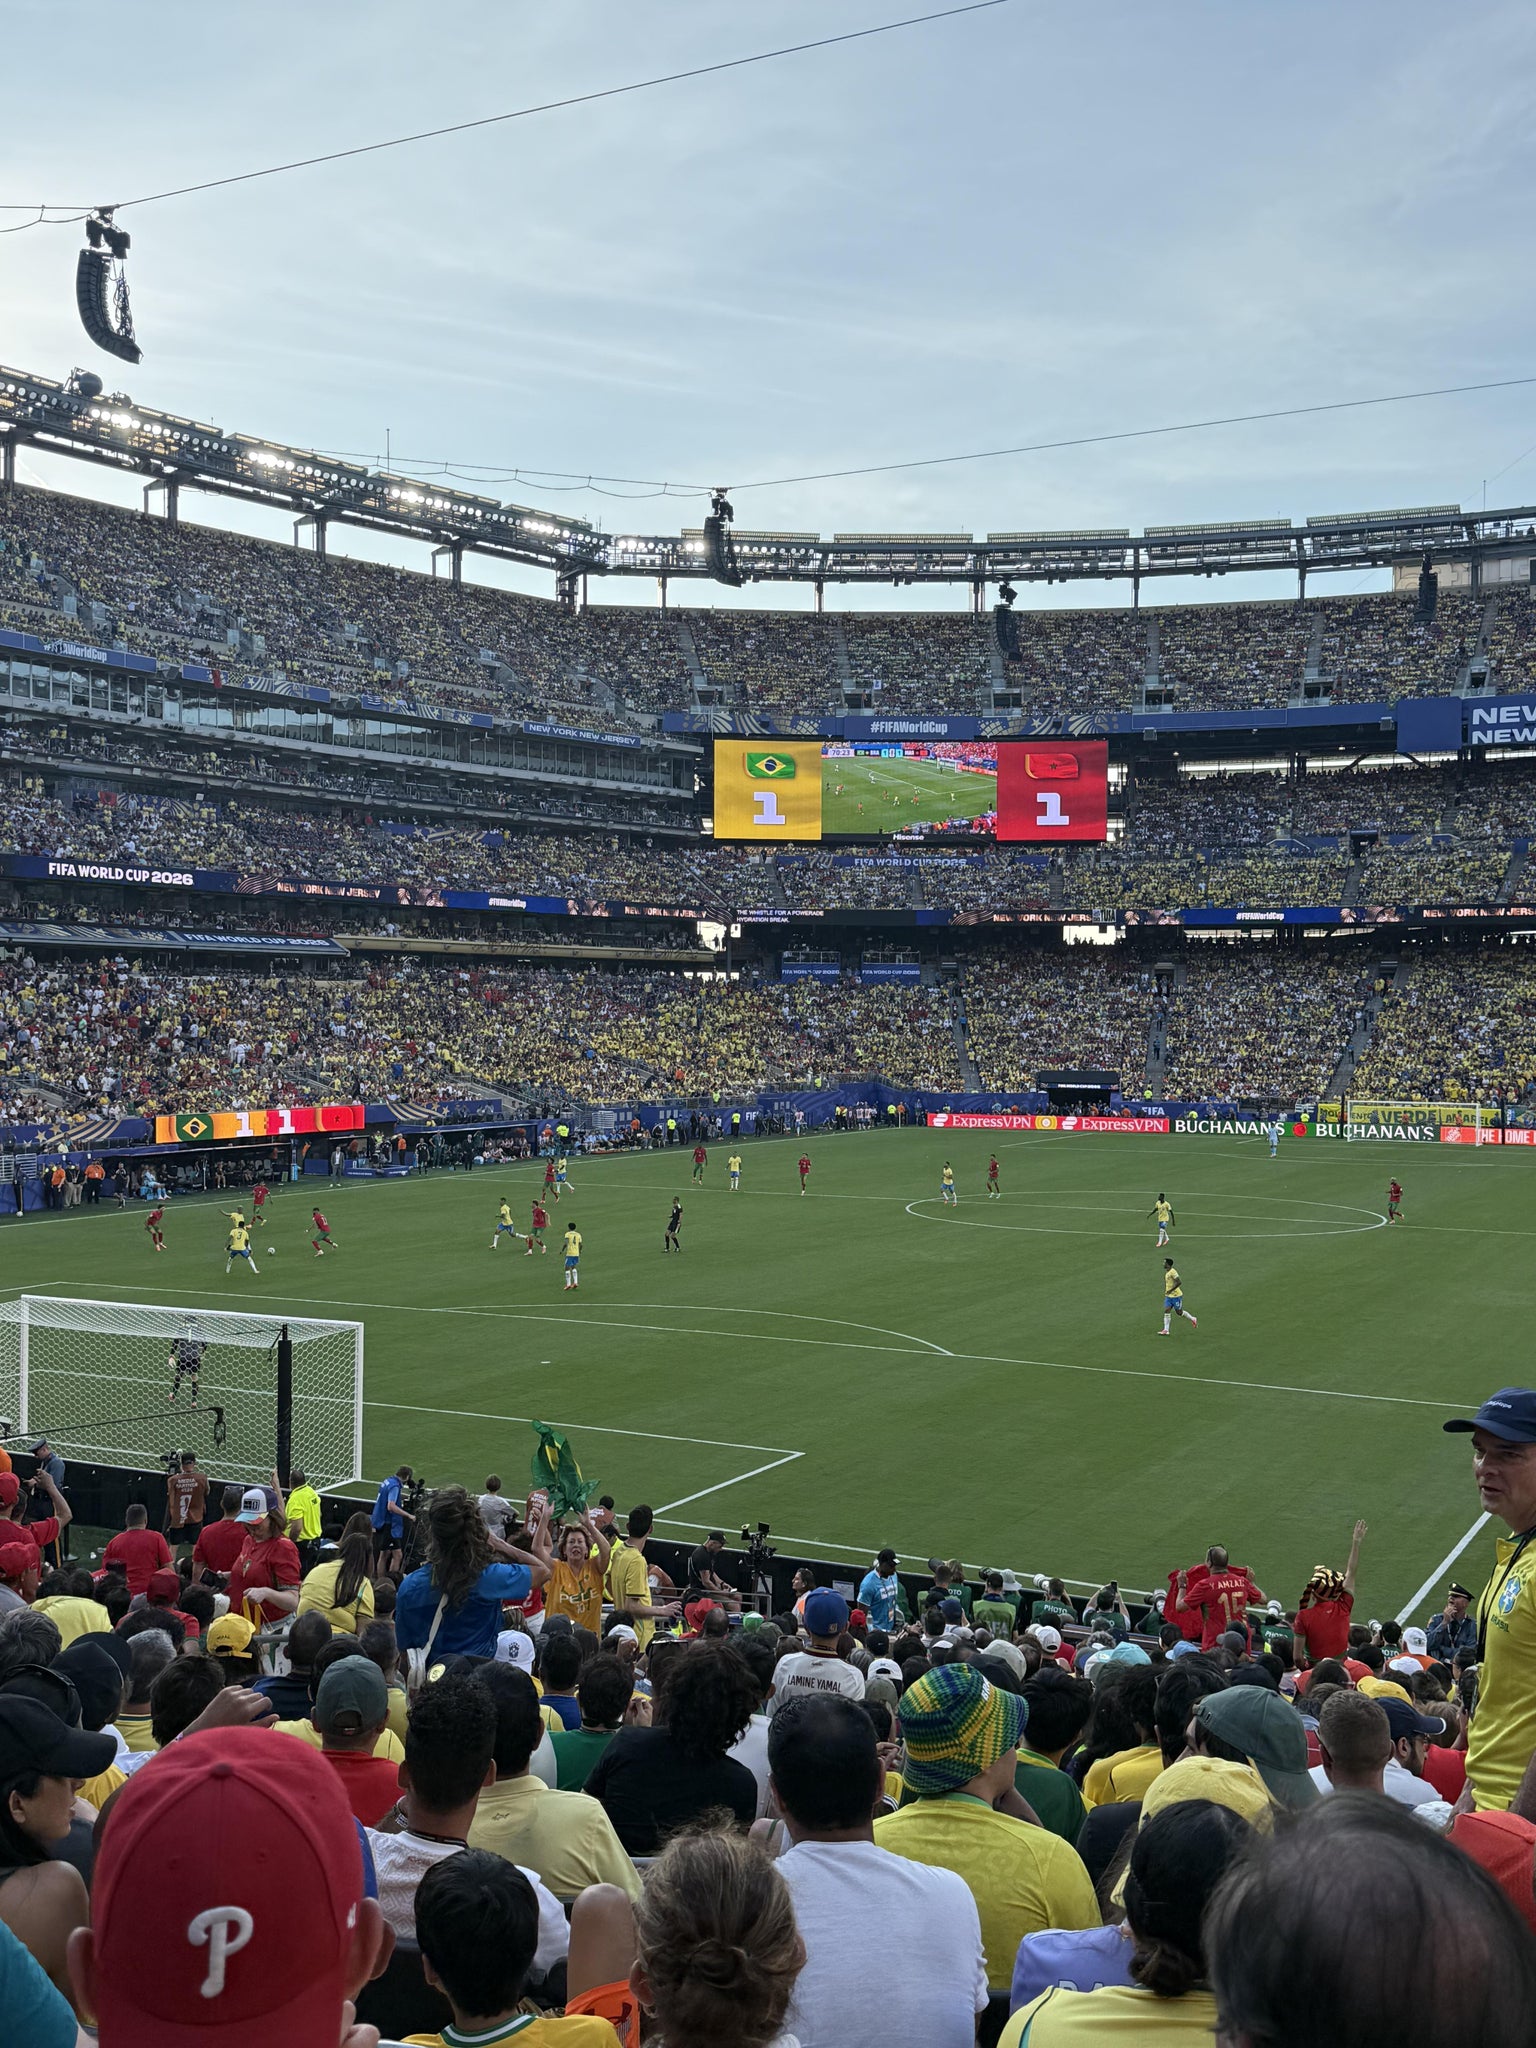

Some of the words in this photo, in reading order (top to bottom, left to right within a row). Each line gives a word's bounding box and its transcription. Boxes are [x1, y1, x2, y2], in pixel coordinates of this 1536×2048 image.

[529, 724, 551, 733] NEW
[553, 727, 578, 737] YORK
[579, 731, 600, 740] NEW
[601, 735, 636, 745] JERSEY
[870, 721, 948, 735] #FIFAWorldCup
[1471, 728, 1536, 745] NEW
[753, 791, 786, 825] 1
[1036, 792, 1070, 826] 1
[48, 862, 77, 877] FIFA
[78, 865, 124, 881] WORLD
[125, 869, 150, 882] CUP
[151, 871, 194, 886] 2026
[277, 882, 298, 893] NEW
[301, 884, 323, 895] YORK
[625, 906, 641, 915] NEW
[643, 908, 662, 916] YORK
[993, 914, 1013, 922] NEW
[1018, 914, 1043, 922] YORK
[1067, 914, 1092, 922] JERS
[1236, 912, 1285, 921] #FIFAWorldCup
[1423, 909, 1447, 918] NEW
[1449, 908, 1478, 917] YORK
[1506, 907, 1536, 916] JERS
[184, 933, 214, 942] FIFA
[214, 935, 261, 944] WORLD
[262, 937, 287, 945] CUP
[287, 938, 330, 946] 2026
[1141, 1106, 1165, 1116] FIFA
[236, 1112, 254, 1138] 1
[278, 1109, 296, 1135] 1
[952, 1115, 1031, 1128] ExpressVPN
[1081, 1118, 1164, 1132] ExpressVPN
[1175, 1120, 1286, 1136] BUCHANAN'S
[1315, 1123, 1435, 1140] BUCHANAN'S
[559, 1587, 600, 1604] PELE
[1043, 1604, 1068, 1615] PHOTO
[787, 1674, 816, 1689] LAMINE
[817, 1678, 842, 1693] YAMAL
[187, 1905, 254, 1999] P
